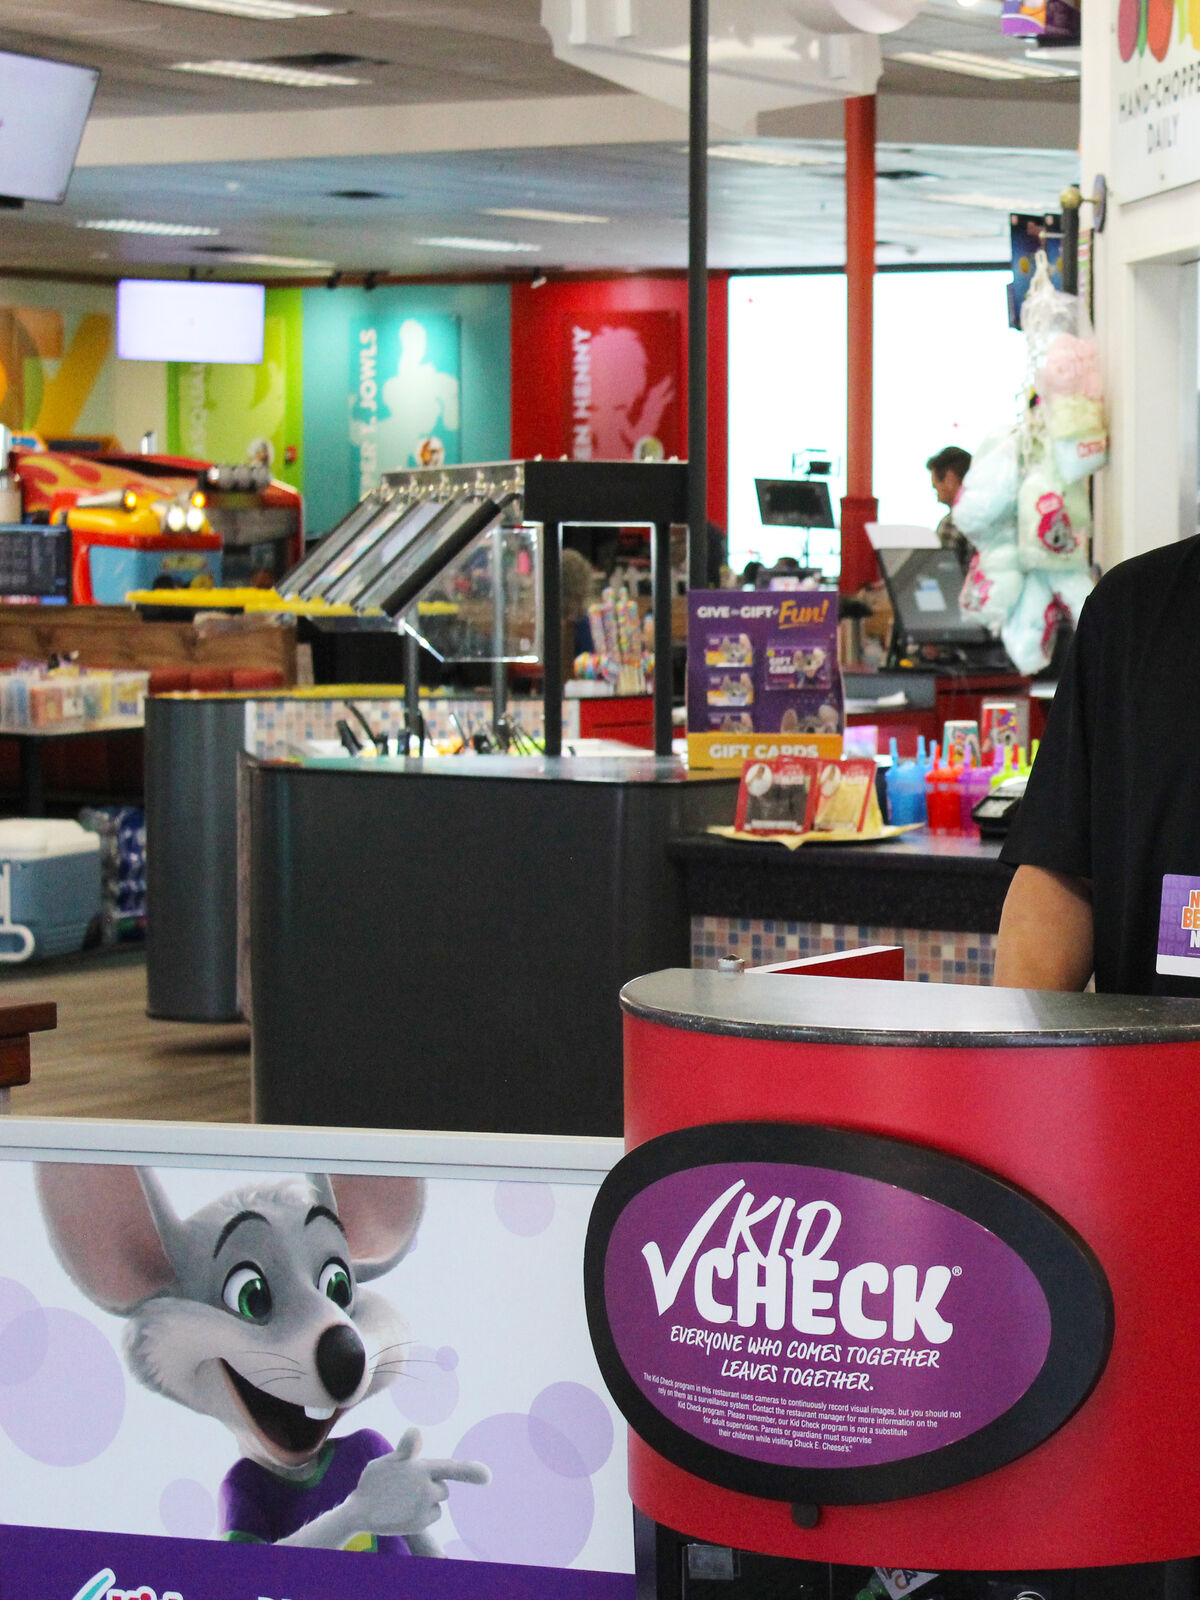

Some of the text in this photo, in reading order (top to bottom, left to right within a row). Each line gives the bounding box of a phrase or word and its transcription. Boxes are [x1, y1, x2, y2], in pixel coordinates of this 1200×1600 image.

[360, 328, 378, 411] JOWLS
[572, 326, 591, 419] HENNY
[698, 606, 730, 618] GIVE
[740, 606, 774, 618] GIFT
[778, 600, 829, 625] Fun!
[709, 744, 819, 759] GIFT CARDS
[725, 1192, 842, 1267] KID
[670, 1326, 940, 1368] EVERYONE WHO COMES TOGETHER
[721, 1360, 874, 1392] LEAVES TOGETHER.
[660, 1377, 673, 1386] Check
[675, 1382, 695, 1391] program
[702, 1386, 711, 1394] this
[713, 1388, 739, 1398] restaurant
[755, 1395, 779, 1404] cameras
[788, 1400, 827, 1411] continuously
[850, 1405, 869, 1413] visual
[871, 1406, 896, 1416] images,
[898, 1408, 909, 1416] but
[911, 1410, 923, 1418] you
[925, 1410, 948, 1418] should
[674, 1390, 686, 1399] them
[698, 1396, 728, 1407] surveillance
[752, 1404, 774, 1413] Contact
[776, 1407, 785, 1415] the
[786, 1408, 816, 1418] restaurant
[818, 1413, 845, 1422] manager
[877, 1417, 914, 1426] information
[927, 1420, 938, 1428] the
[687, 1402, 701, 1412] Check
[703, 1406, 726, 1416] program.
[728, 1410, 745, 1420] Please
[747, 1414, 776, 1424] remember,
[801, 1420, 820, 1429] Check
[821, 1423, 848, 1432] program
[875, 1428, 907, 1436] substitute
[726, 1421, 759, 1431] supervision.
[761, 1425, 783, 1435] Parents
[792, 1430, 821, 1439] guardians
[840, 1435, 872, 1444] supervise
[719, 1429, 731, 1437] their
[732, 1430, 754, 1440] children
[755, 1435, 770, 1443] while
[772, 1437, 792, 1447] visiting
[794, 1440, 813, 1448] Chuck
